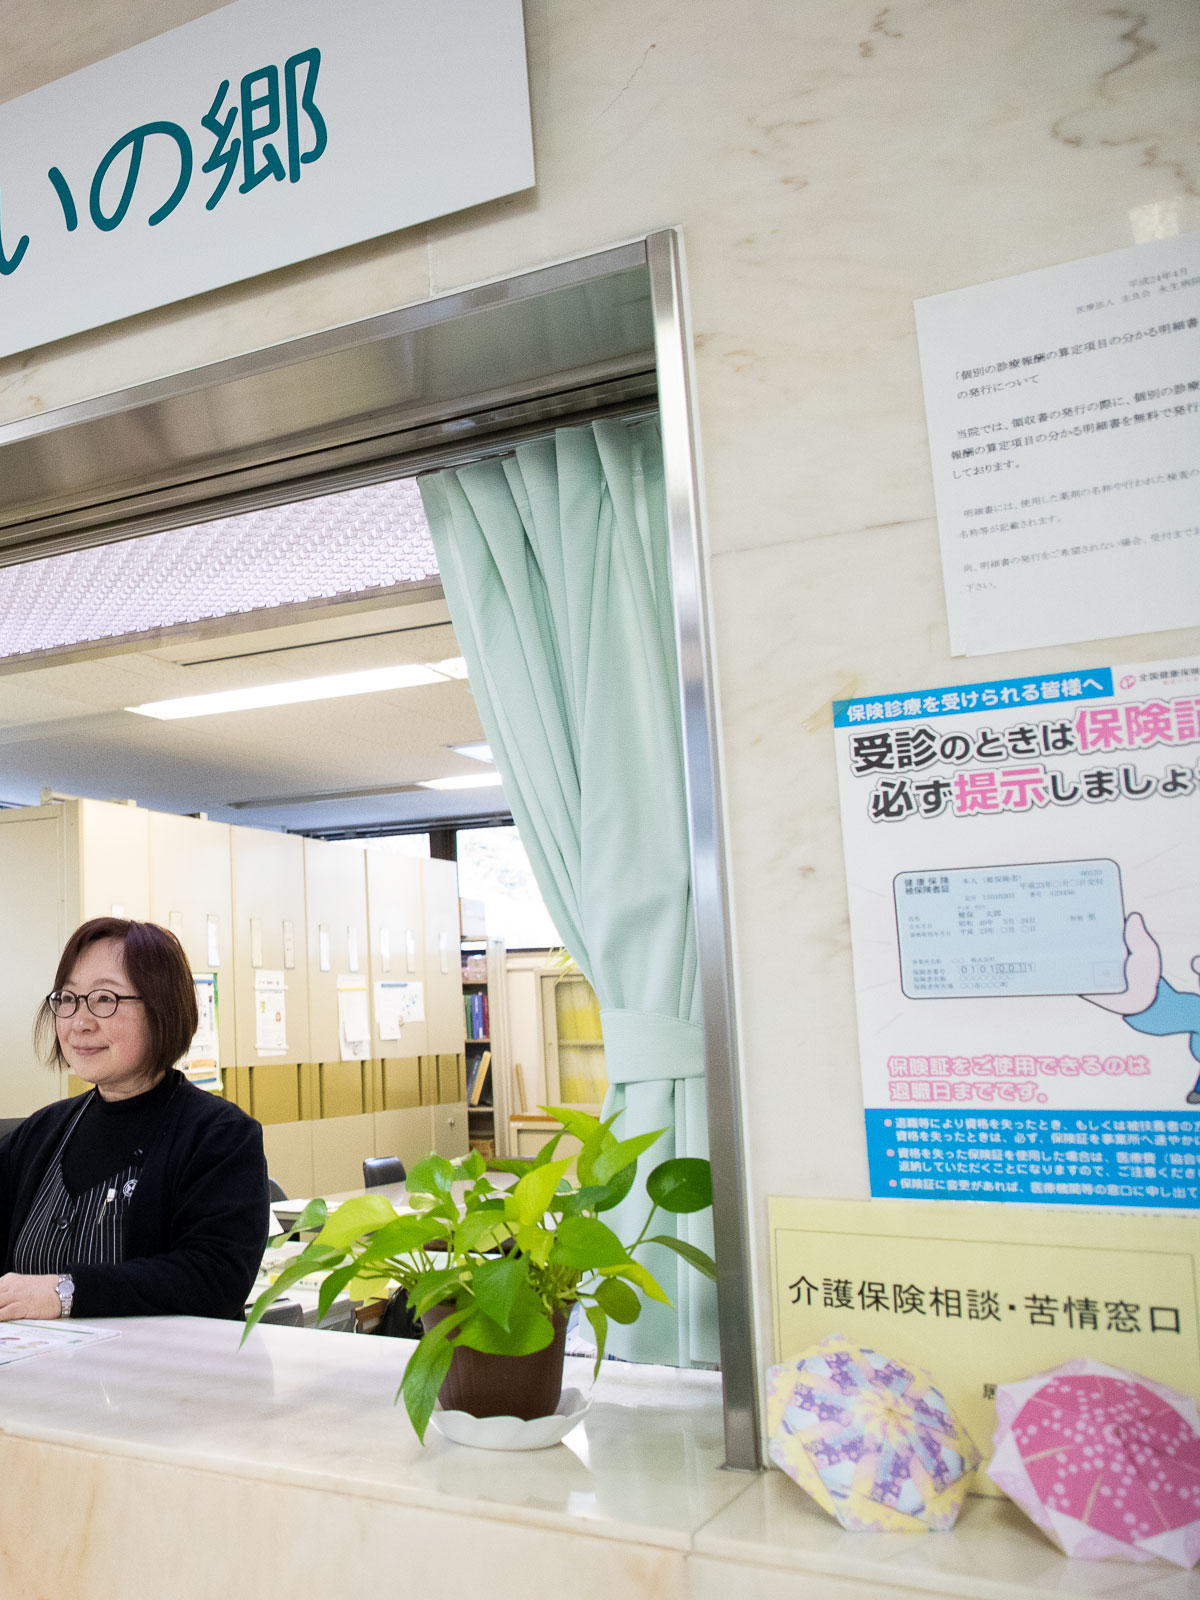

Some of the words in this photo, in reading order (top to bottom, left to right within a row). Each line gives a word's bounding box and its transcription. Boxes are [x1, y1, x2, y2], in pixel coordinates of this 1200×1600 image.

[957, 374, 1040, 399] の発行について
[952, 459, 1021, 480] しております。
[847, 677, 1104, 722] 保険診療を受けられる皆様へ
[872, 766, 1200, 820] 必ず提示しましょ
[887, 1055, 1150, 1077] 保険証をご使用できるのは
[889, 1081, 1048, 1103] 退職日までです。
[788, 1275, 1182, 1335] 介護保険相談・苦情窓口
